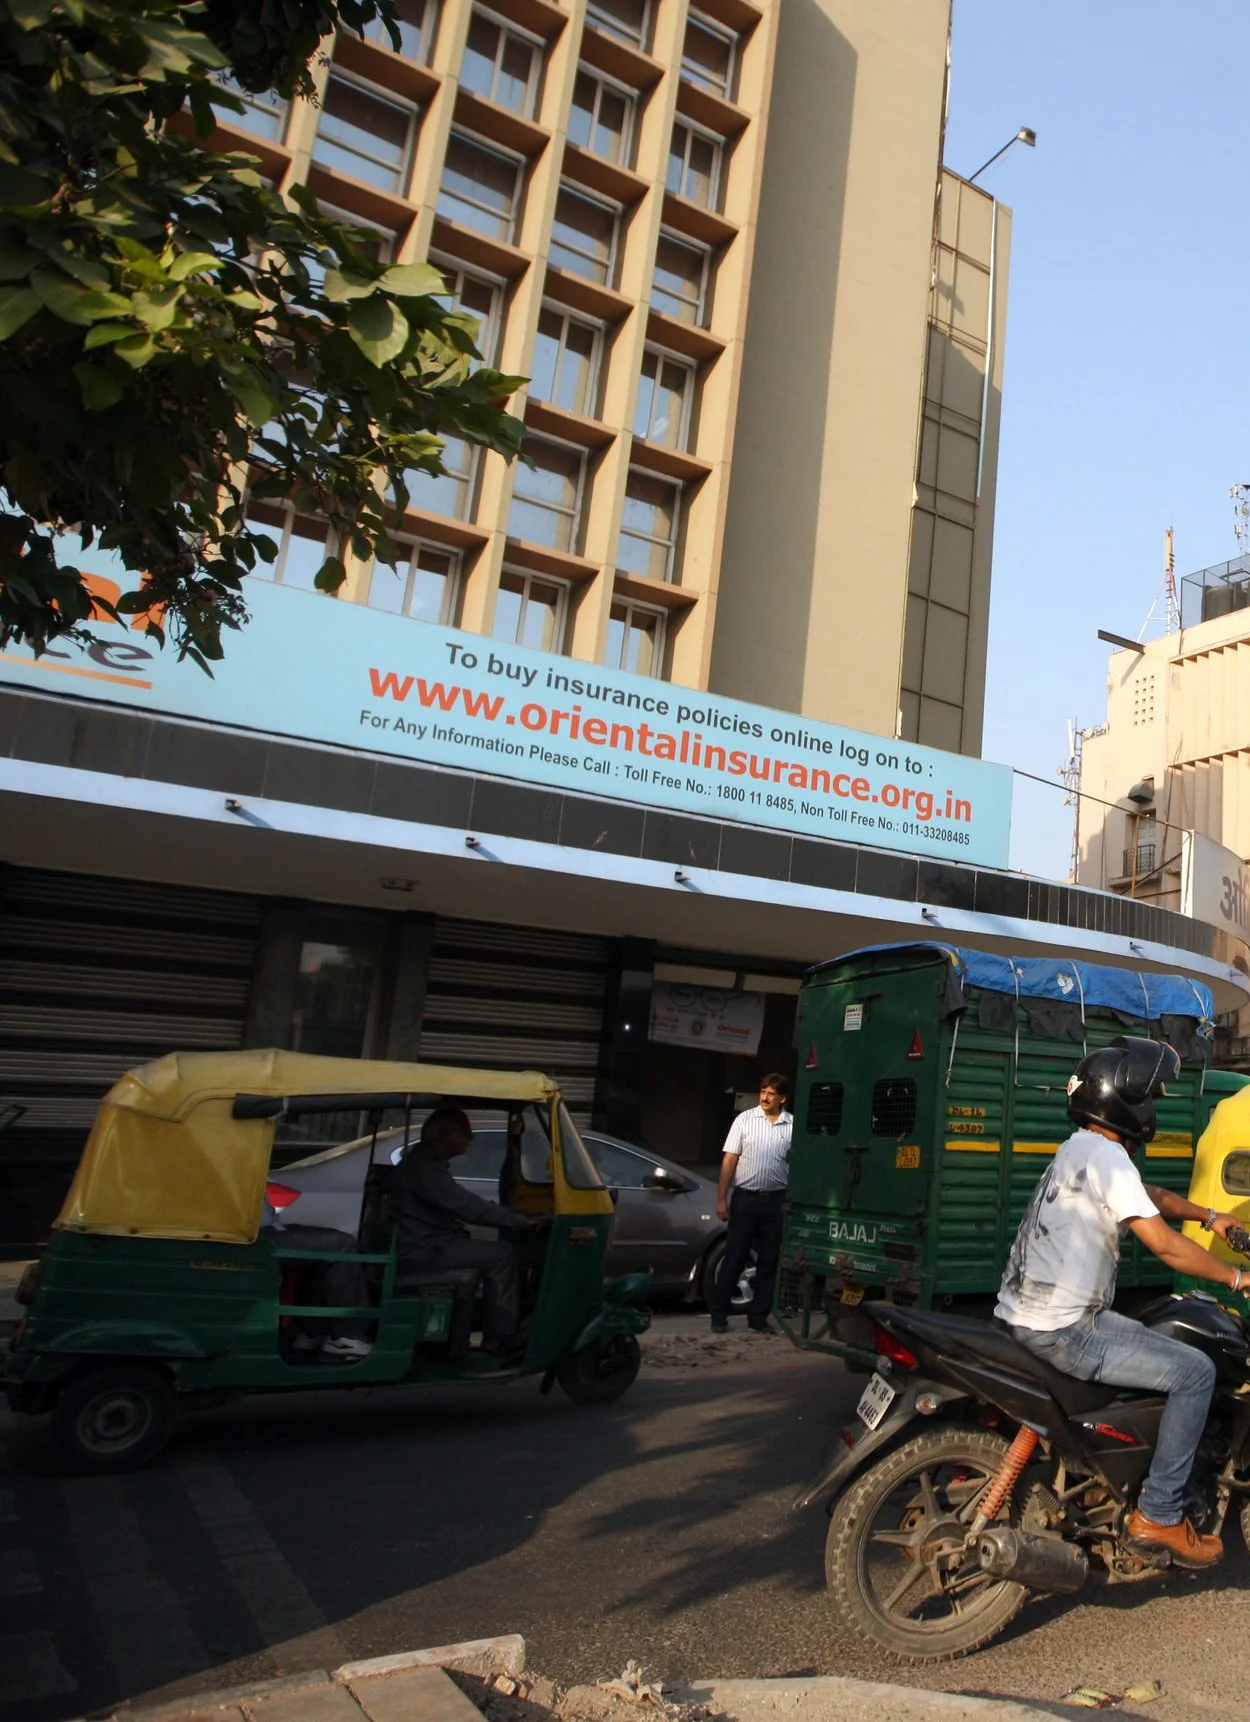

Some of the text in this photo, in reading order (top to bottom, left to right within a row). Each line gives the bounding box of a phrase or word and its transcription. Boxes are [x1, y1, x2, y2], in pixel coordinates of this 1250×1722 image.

[369, 668, 973, 823] www.orientalinsurance.org.in
[446, 643, 478, 669] To
[487, 653, 539, 687] buy
[546, 667, 669, 716] insurance
[676, 705, 763, 738] policies
[770, 727, 833, 755] online
[839, 739, 870, 767] log
[875, 752, 899, 770] on
[904, 756, 923, 775] to
[359, 710, 389, 729] For
[393, 717, 427, 740] Any
[432, 724, 525, 757] Information
[529, 745, 579, 768] Please
[583, 756, 611, 775] Call
[624, 764, 649, 782] Toll
[652, 770, 682, 790] Free
[686, 778, 712, 796] No.:
[717, 785, 746, 802] 1800
[749, 791, 762, 804] 11
[765, 795, 797, 814] 8485,
[800, 801, 824, 818] Non
[827, 806, 848, 822] Toll
[850, 811, 875, 827] Free
[878, 816, 900, 833] No.:
[902, 822, 970, 846] 011-33208485
[829, 1221, 877, 1243] BAJAJ
